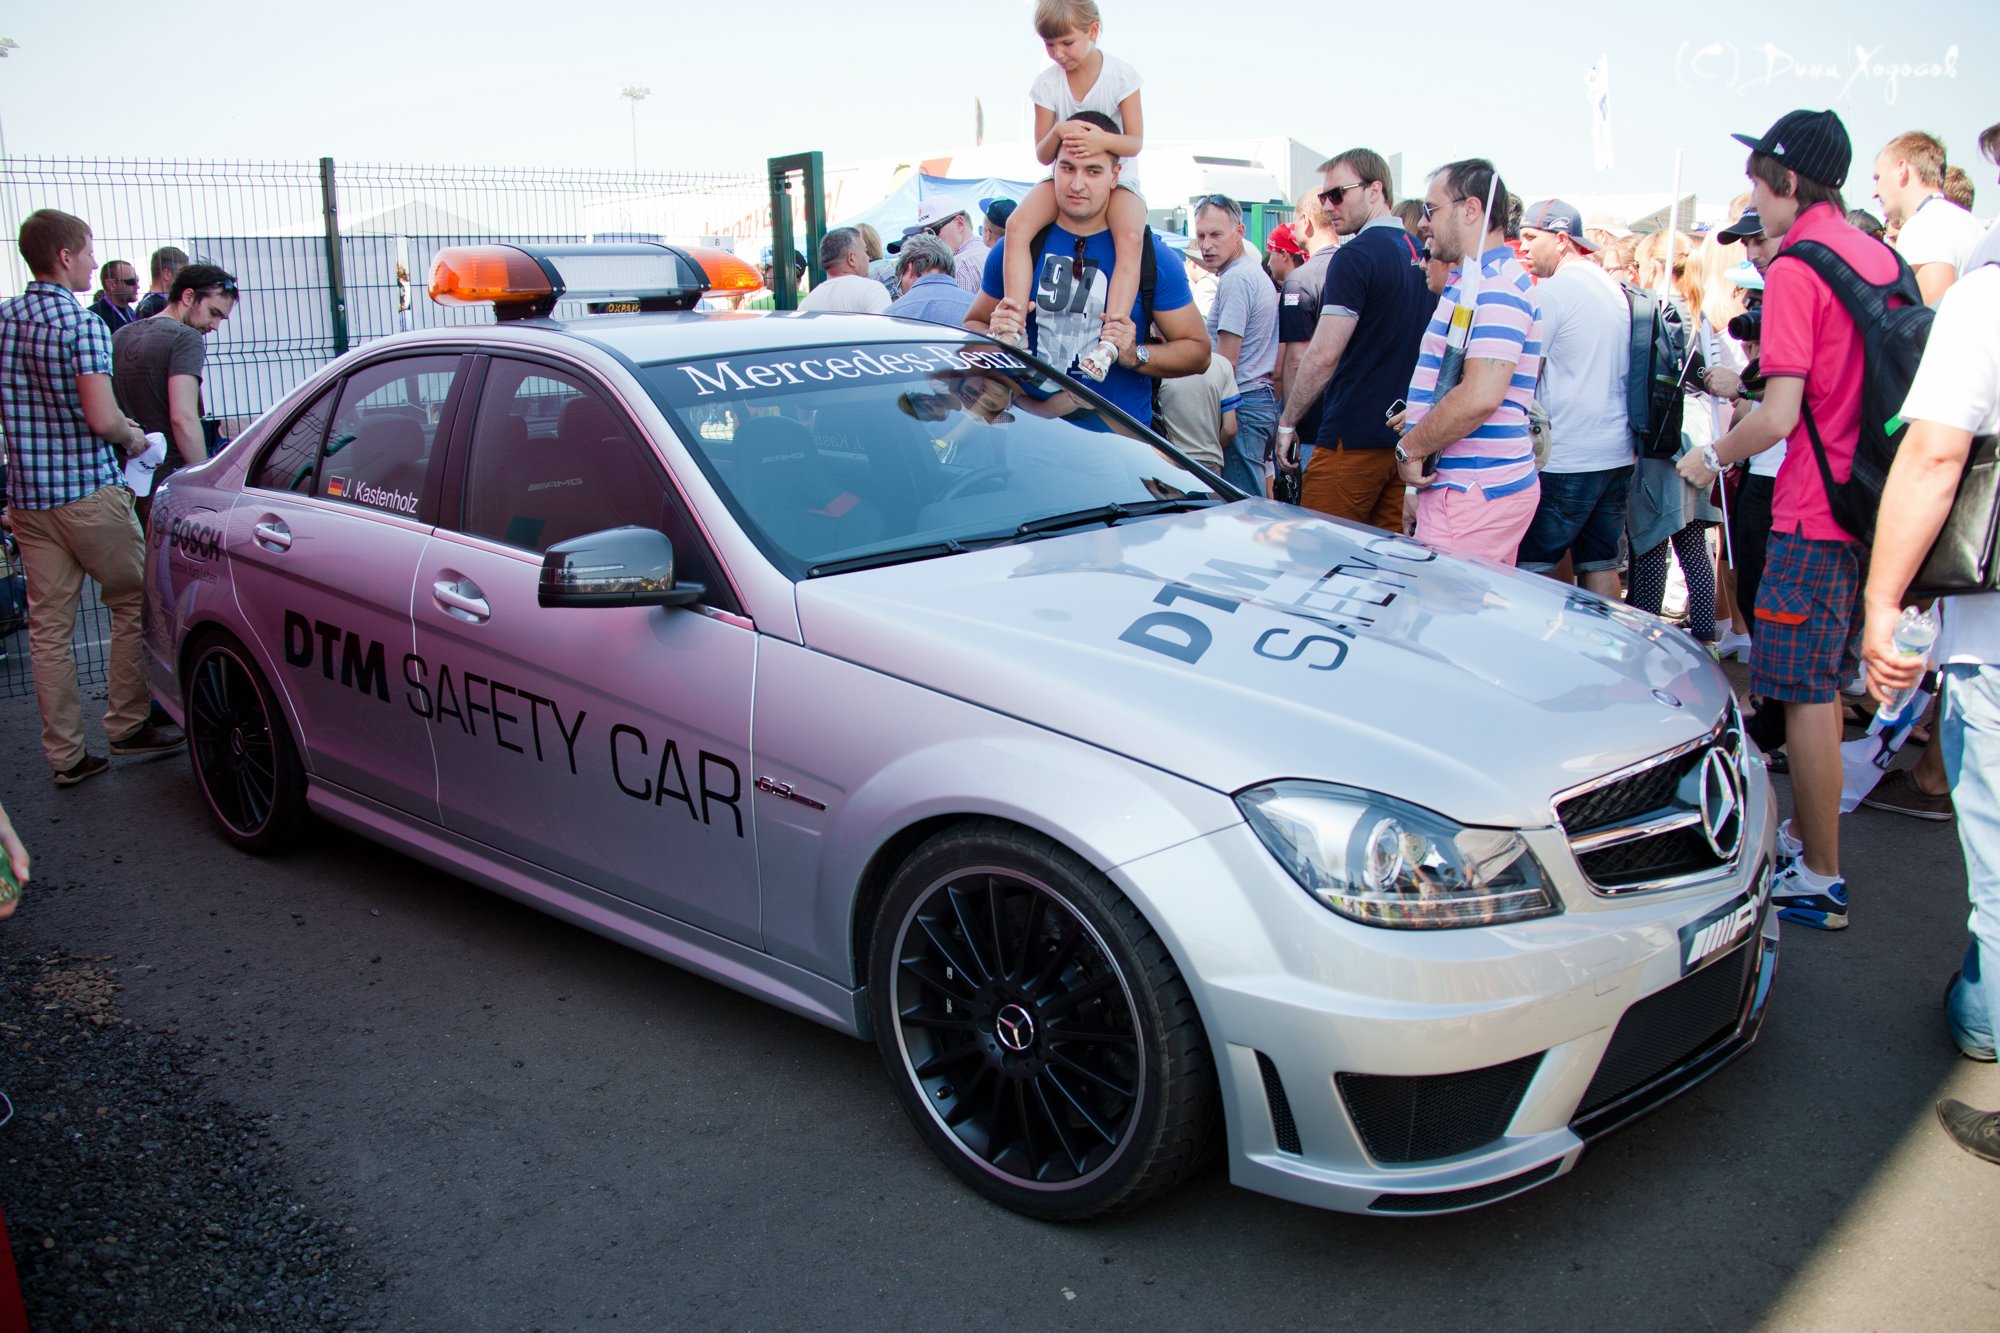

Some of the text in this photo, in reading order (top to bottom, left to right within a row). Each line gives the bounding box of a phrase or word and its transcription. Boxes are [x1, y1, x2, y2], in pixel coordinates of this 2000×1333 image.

[676, 346, 1027, 396] Mercedes-Benz
[342, 478, 419, 514] J. Kastenholz
[169, 517, 222, 562] BOSCH
[1117, 558, 1285, 665] DTM
[284, 608, 744, 839] DTM SAFETY CAR
